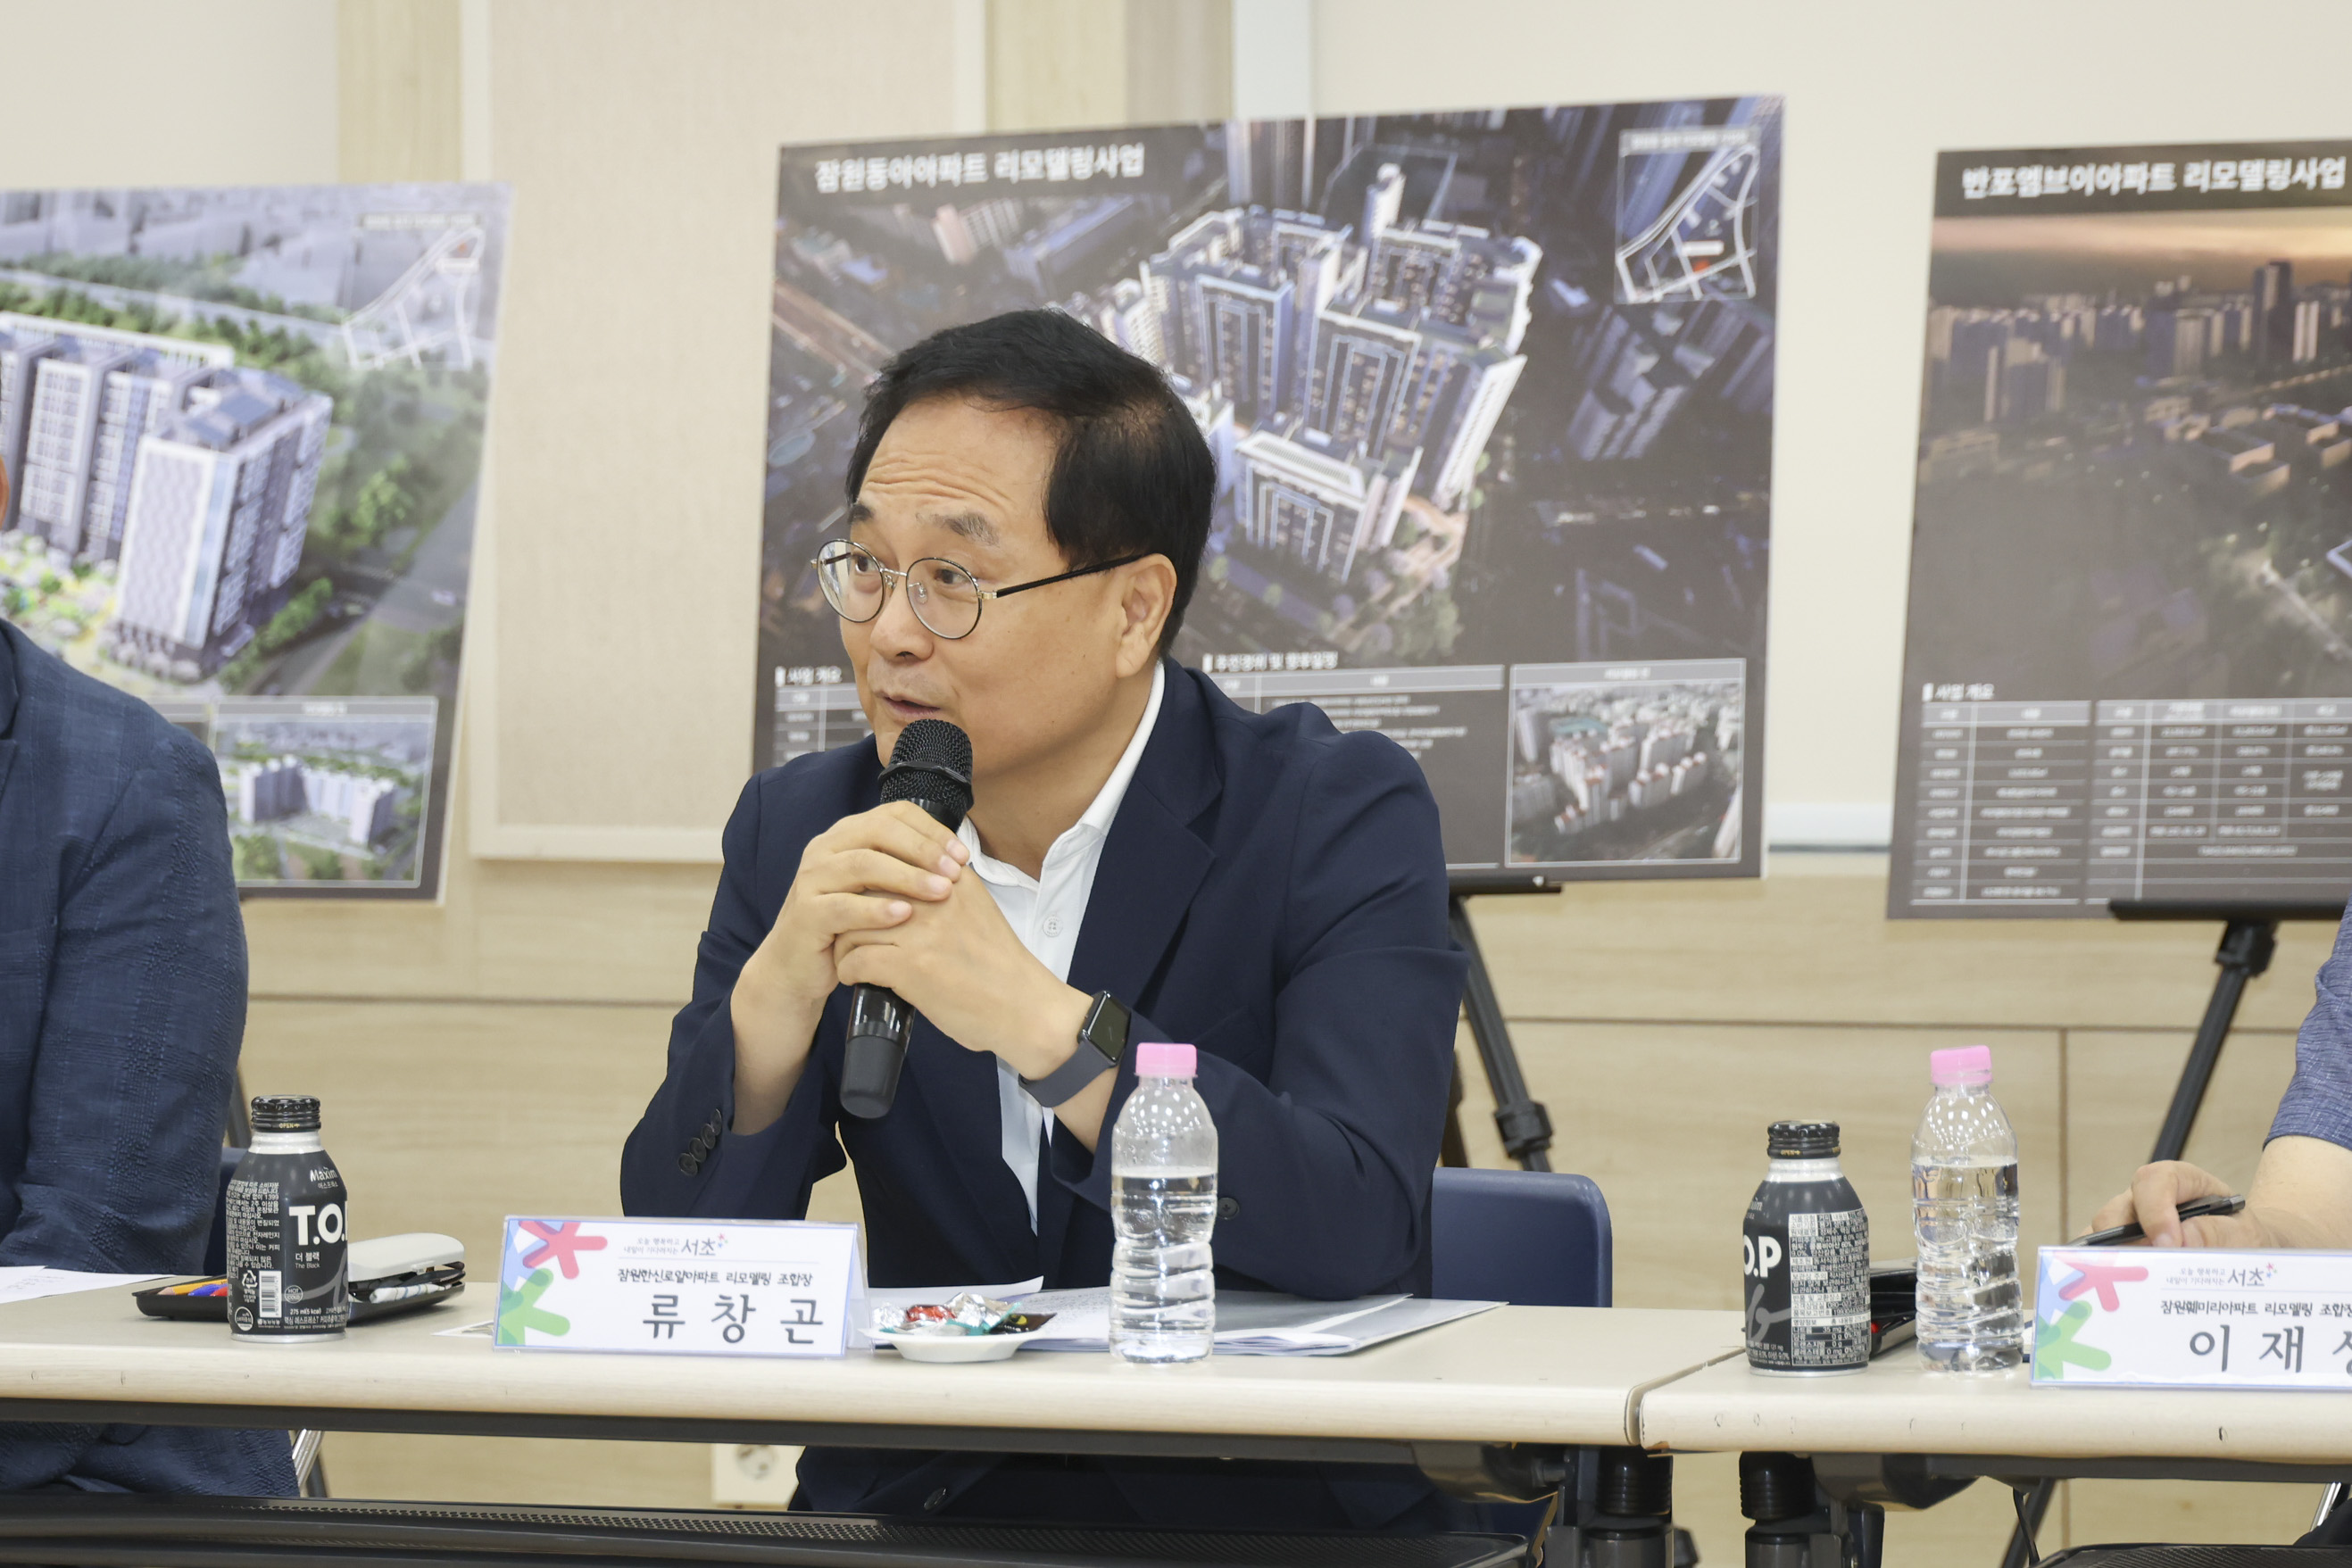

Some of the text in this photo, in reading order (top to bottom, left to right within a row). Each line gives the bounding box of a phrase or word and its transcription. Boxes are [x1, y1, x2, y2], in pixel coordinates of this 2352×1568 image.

[994, 142, 1144, 184] 리모델링사업
[2183, 156, 2347, 193] 리모델링사업
[310, 1166, 338, 1182] Maxim
[288, 1203, 347, 1246] T.O.
[295, 1251, 320, 1262] 더 블랙
[681, 1237, 716, 1256] 서초
[726, 1271, 771, 1286] 리모델링
[777, 1273, 814, 1287] 조합장
[2227, 1267, 2265, 1287] 서초
[2264, 1301, 2314, 1316] 리모델링
[643, 1294, 824, 1344] 류 창 곤
[2190, 1324, 2231, 1373] 이
[2259, 1326, 2305, 1373] 재
